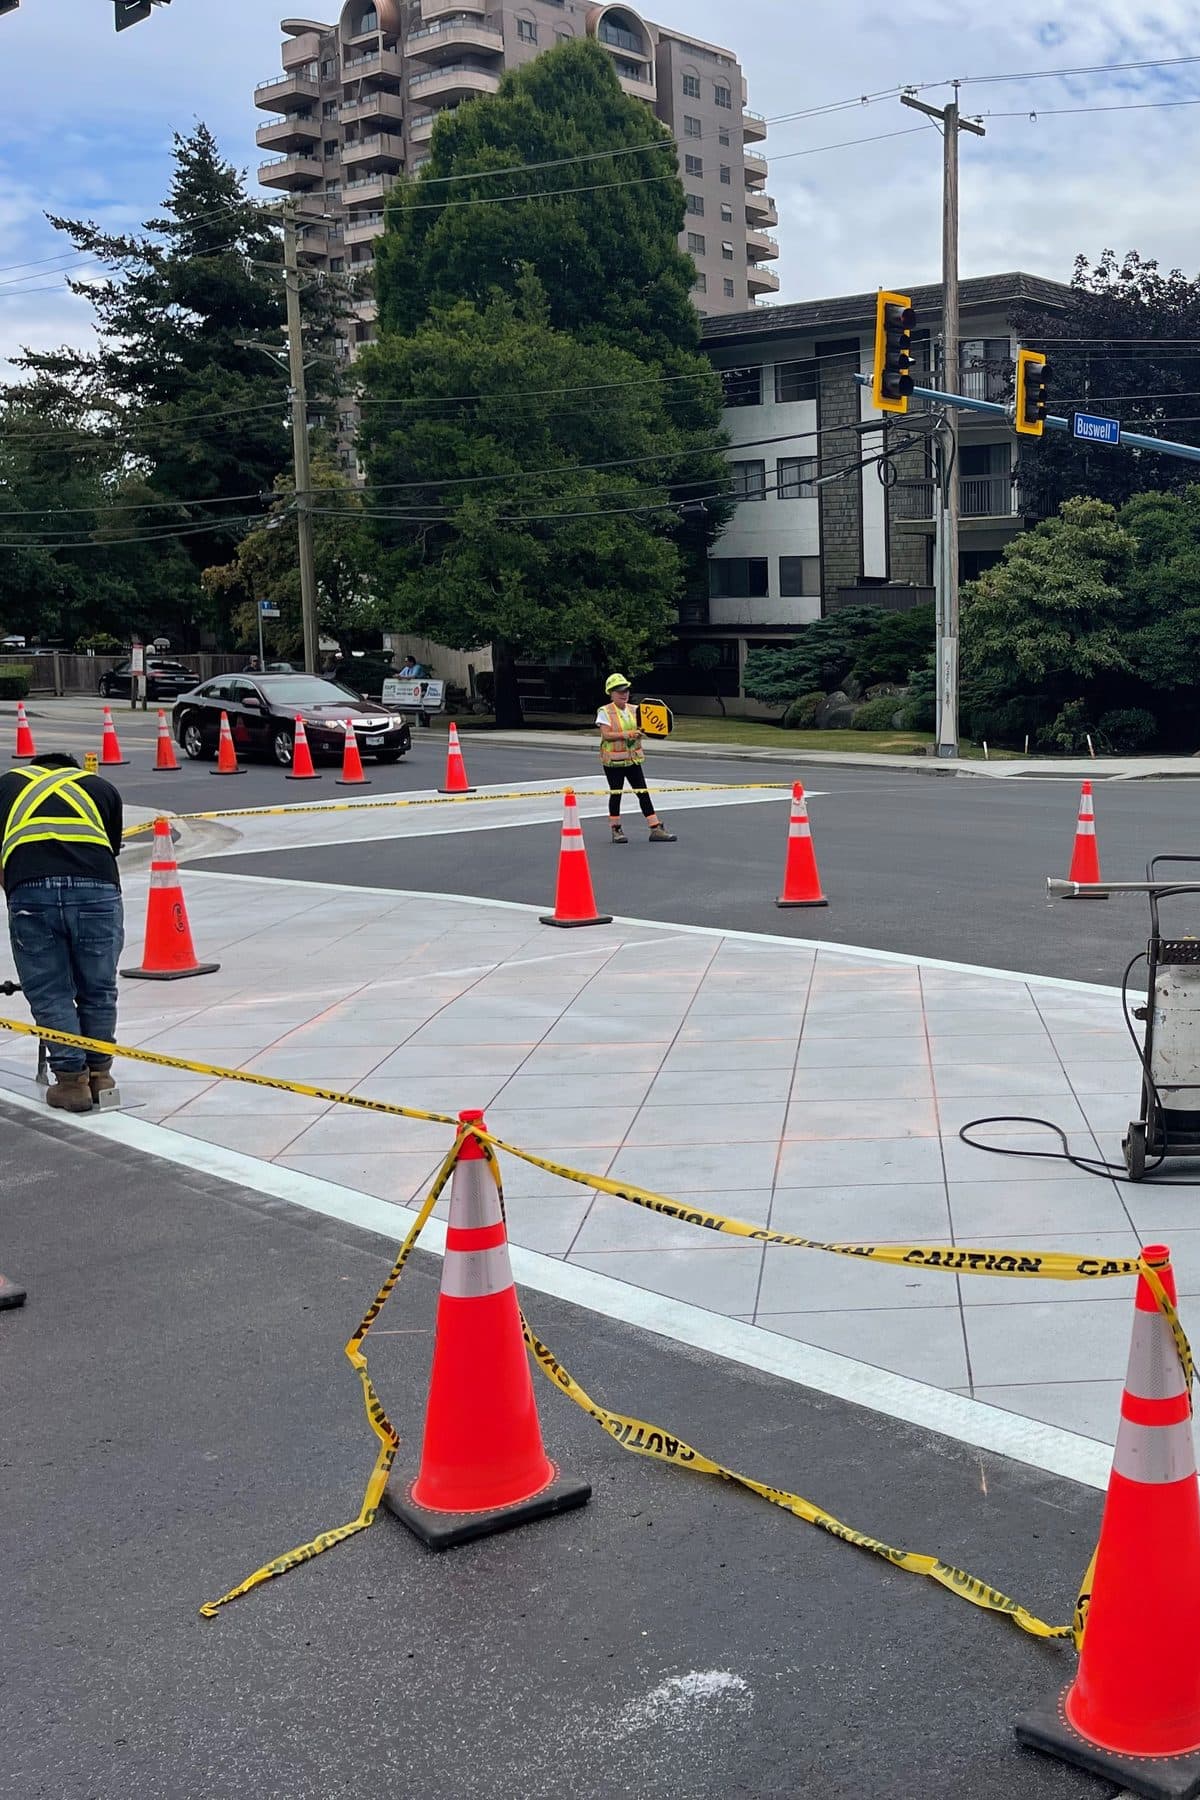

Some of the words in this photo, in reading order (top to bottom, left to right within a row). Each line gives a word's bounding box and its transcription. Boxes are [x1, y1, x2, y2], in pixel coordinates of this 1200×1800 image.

[1077, 417, 1111, 440] Buswell
[642, 706, 666, 732] SLOW
[903, 1250, 1042, 1273] CAUTION
